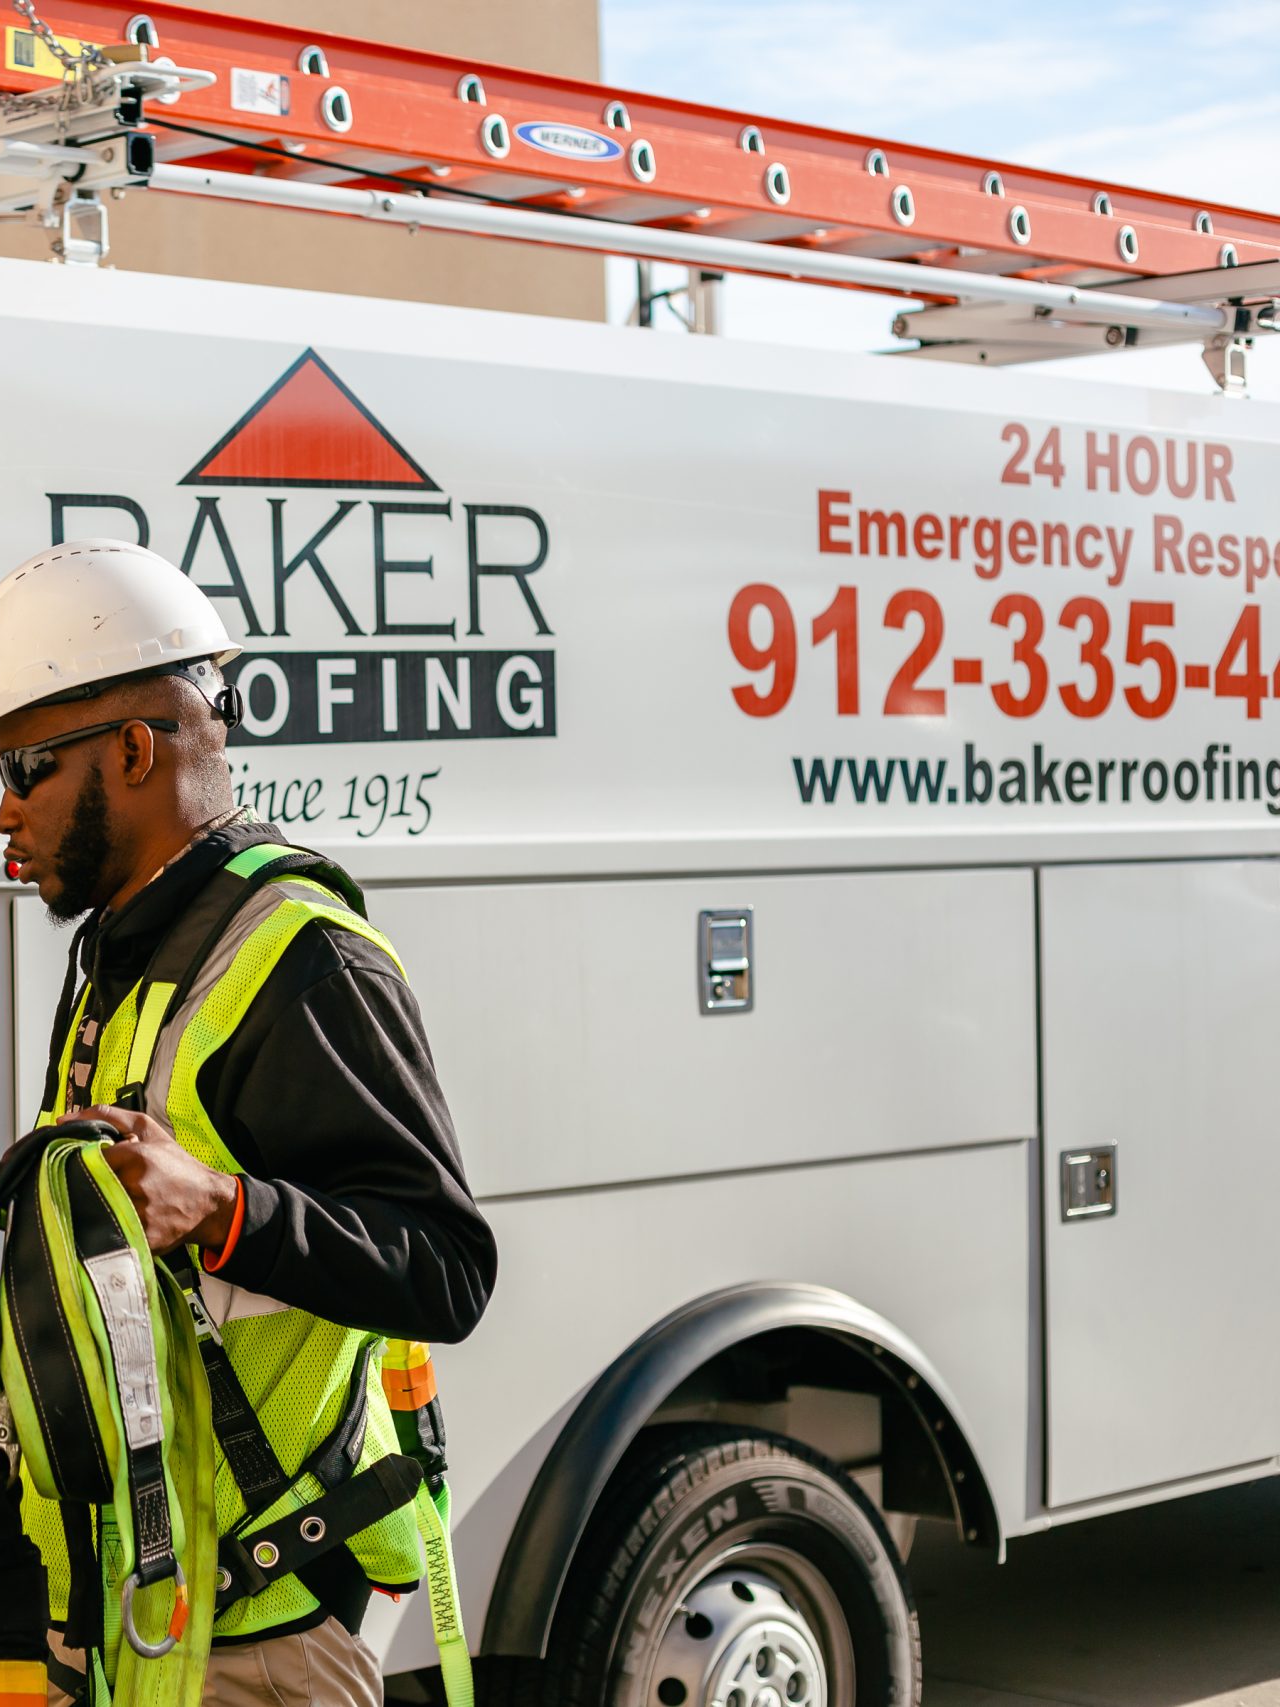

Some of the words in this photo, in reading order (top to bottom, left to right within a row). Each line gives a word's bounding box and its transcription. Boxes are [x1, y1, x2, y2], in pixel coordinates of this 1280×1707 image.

[1001, 423, 1066, 487] 24
[1086, 431, 1236, 503] HOUR
[817, 489, 1134, 588] Emergency
[1154, 515, 1280, 593] Resp
[727, 583, 1280, 720] 912-335-4
[236, 655, 545, 738] OFING
[229, 763, 326, 823] ince
[338, 766, 443, 838] 1915
